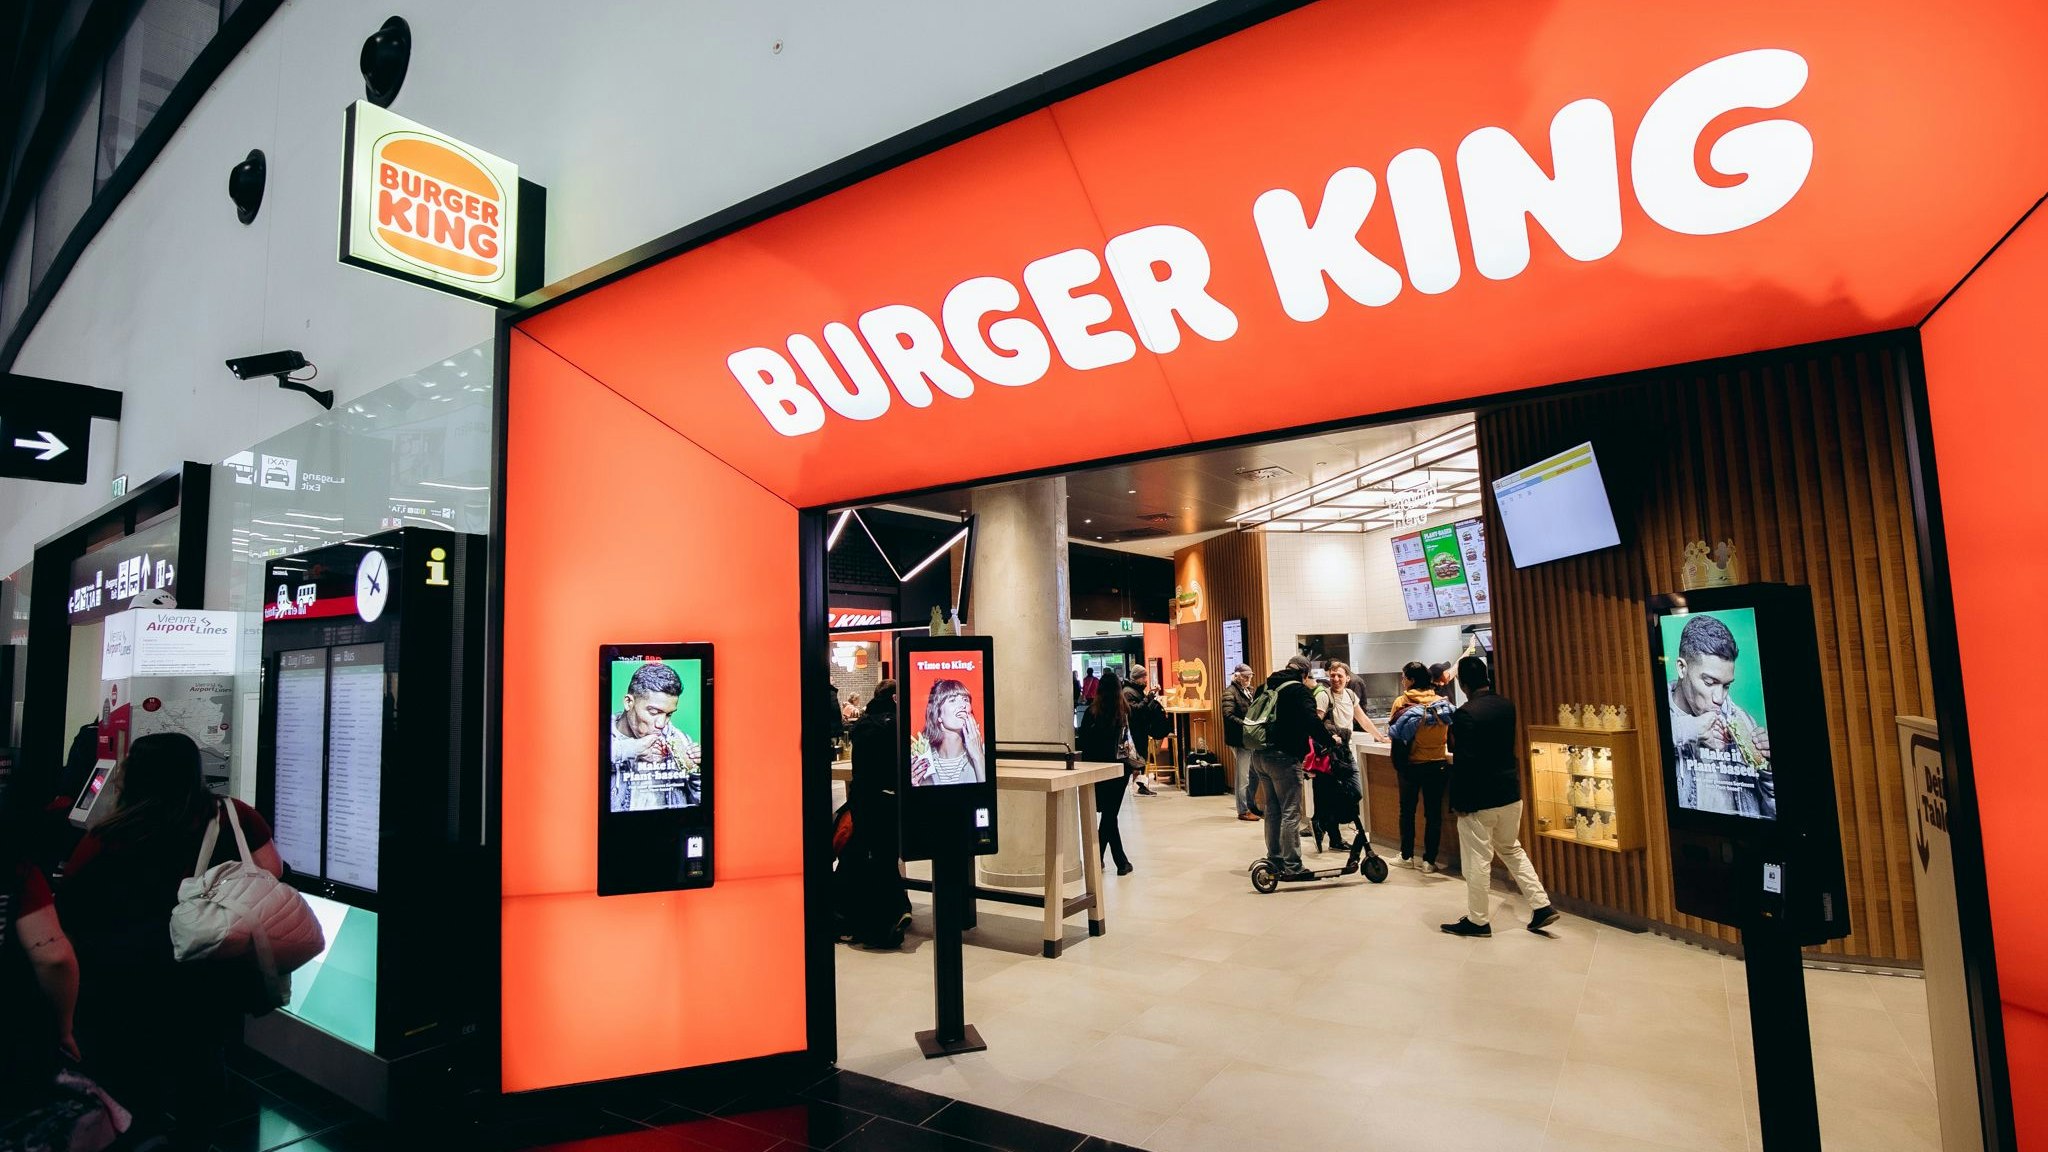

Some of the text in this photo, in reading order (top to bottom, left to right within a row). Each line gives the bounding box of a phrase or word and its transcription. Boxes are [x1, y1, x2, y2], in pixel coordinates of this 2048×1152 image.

[379, 162, 499, 227] BURGER
[378, 189, 498, 259] KING
[727, 48, 1814, 437] BURGER KING
[158, 614, 197, 624] Vienna
[917, 660, 975, 671] Time to King.
[1699, 747, 1742, 762] Make it
[637, 760, 676, 771] Make it
[1686, 759, 1760, 779] Plant-based.
[623, 769, 690, 782] Plant-based.
[1924, 765, 1944, 798] Dei
